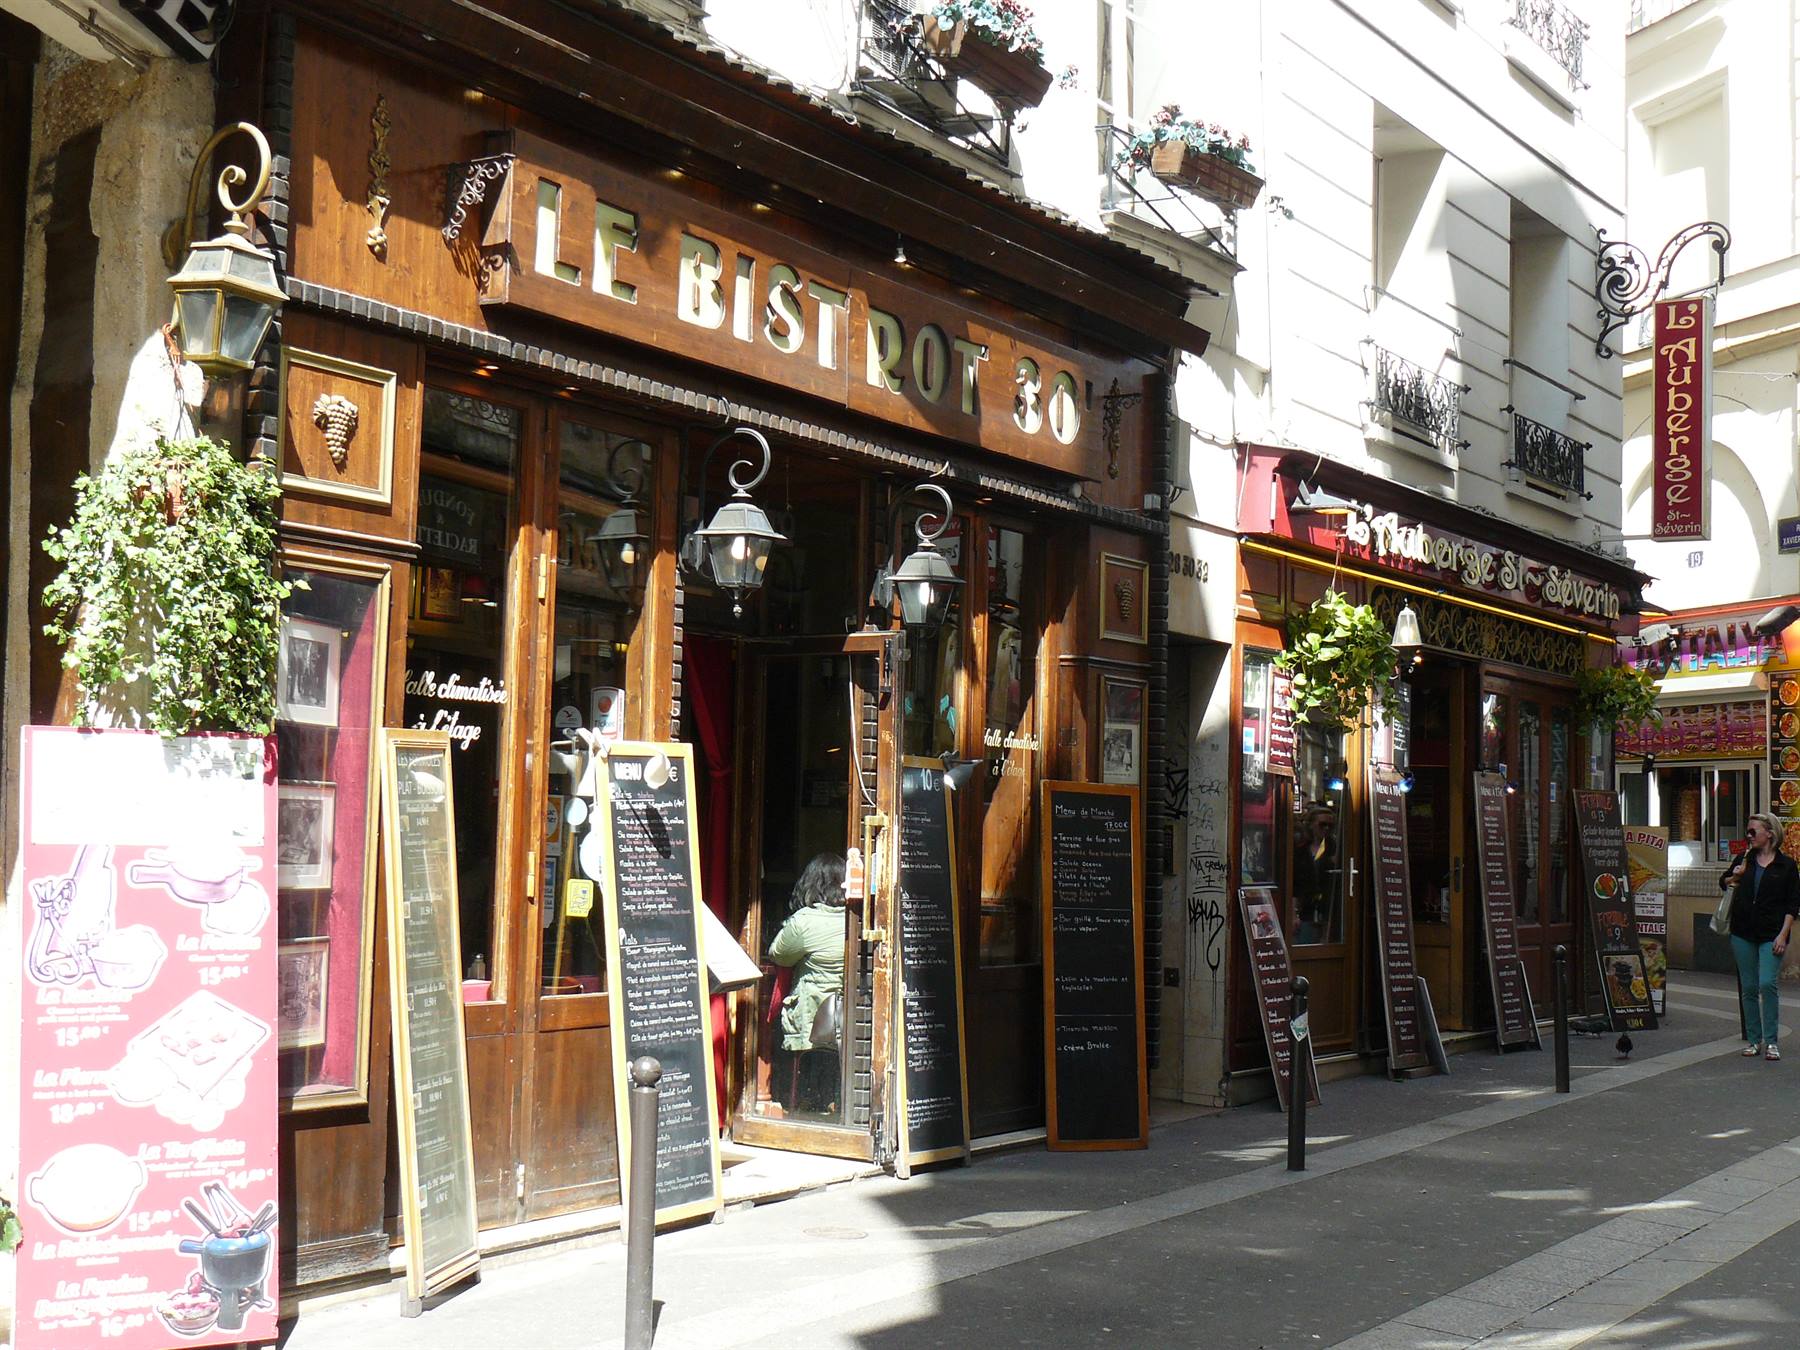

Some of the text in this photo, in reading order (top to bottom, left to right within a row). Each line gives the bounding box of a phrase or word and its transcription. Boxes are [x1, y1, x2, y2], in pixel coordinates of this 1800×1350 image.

[535, 176, 1081, 445] LE BISTROT 30
[1654, 521, 1702, 536] Séverin
[1055, 804, 1076, 816] Menu
[1638, 832, 1665, 849] PITA
